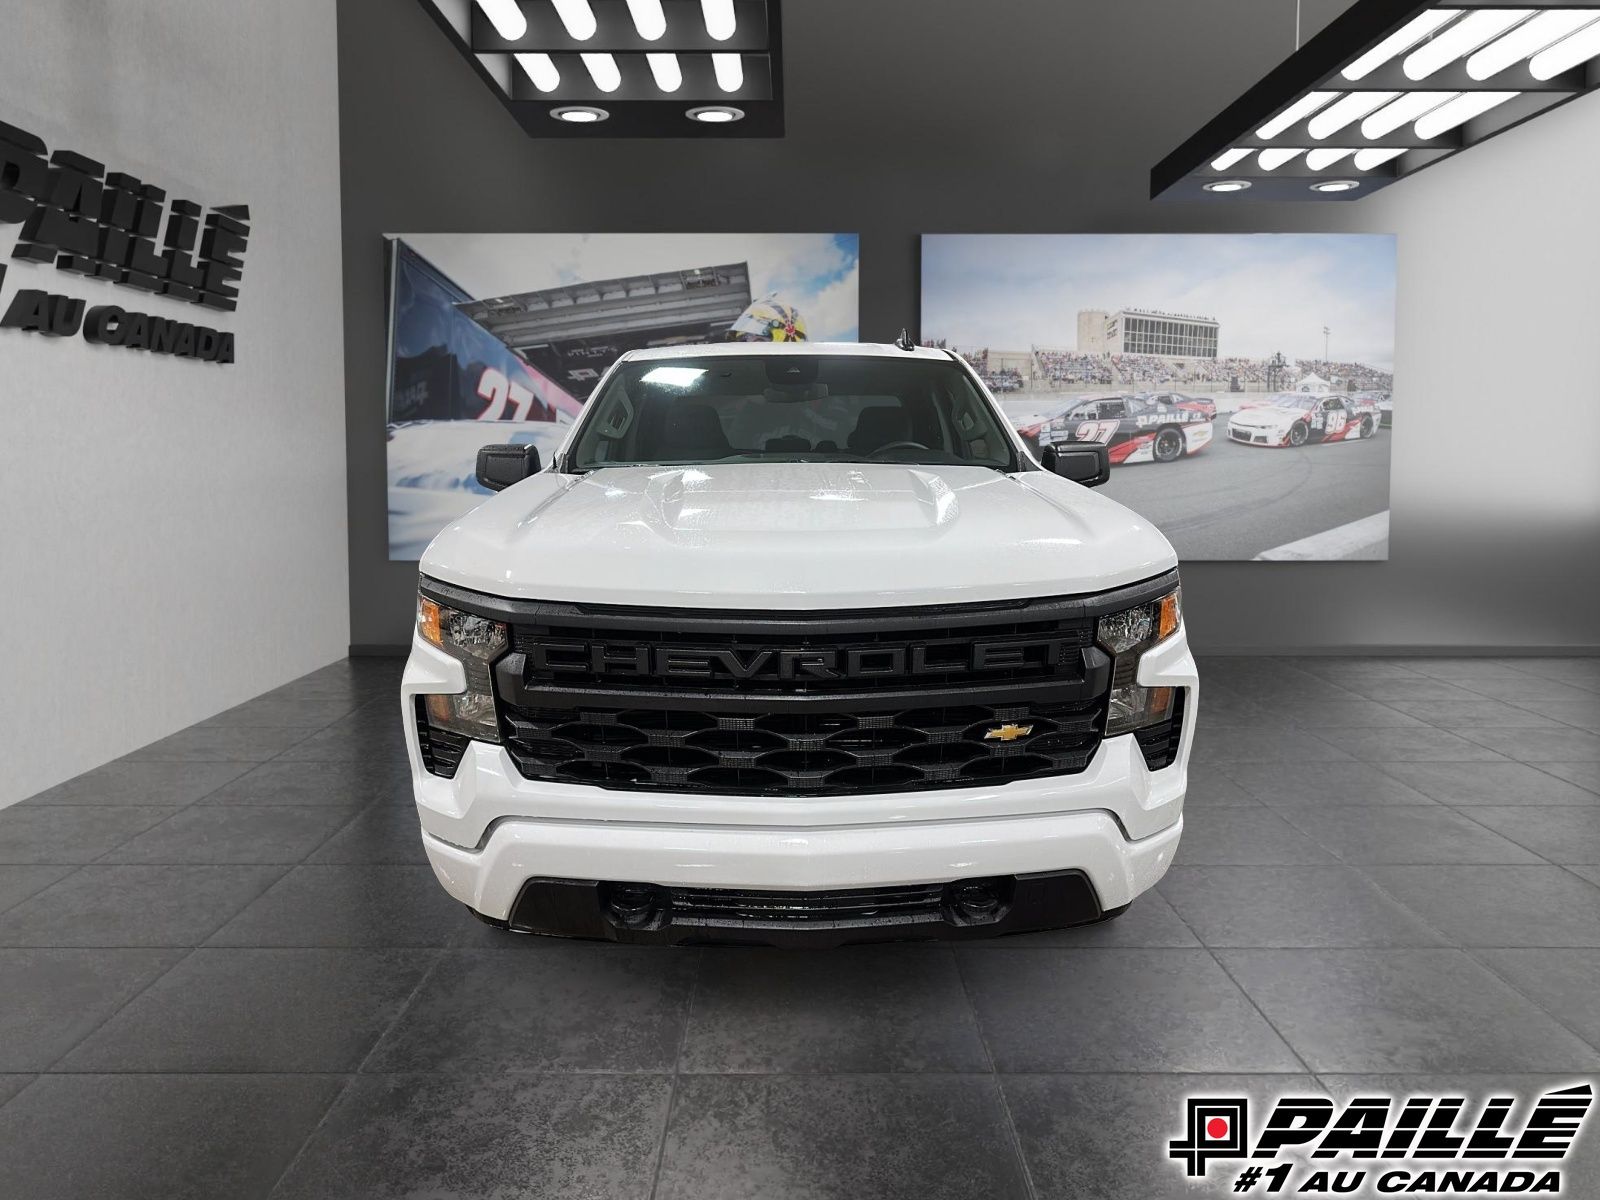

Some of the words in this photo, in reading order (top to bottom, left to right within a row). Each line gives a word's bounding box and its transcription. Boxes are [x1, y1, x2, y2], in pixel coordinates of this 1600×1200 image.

[0, 289, 86, 337] AU
[83, 305, 234, 364] CANADA
[533, 639, 1064, 679] CHEVROLET
